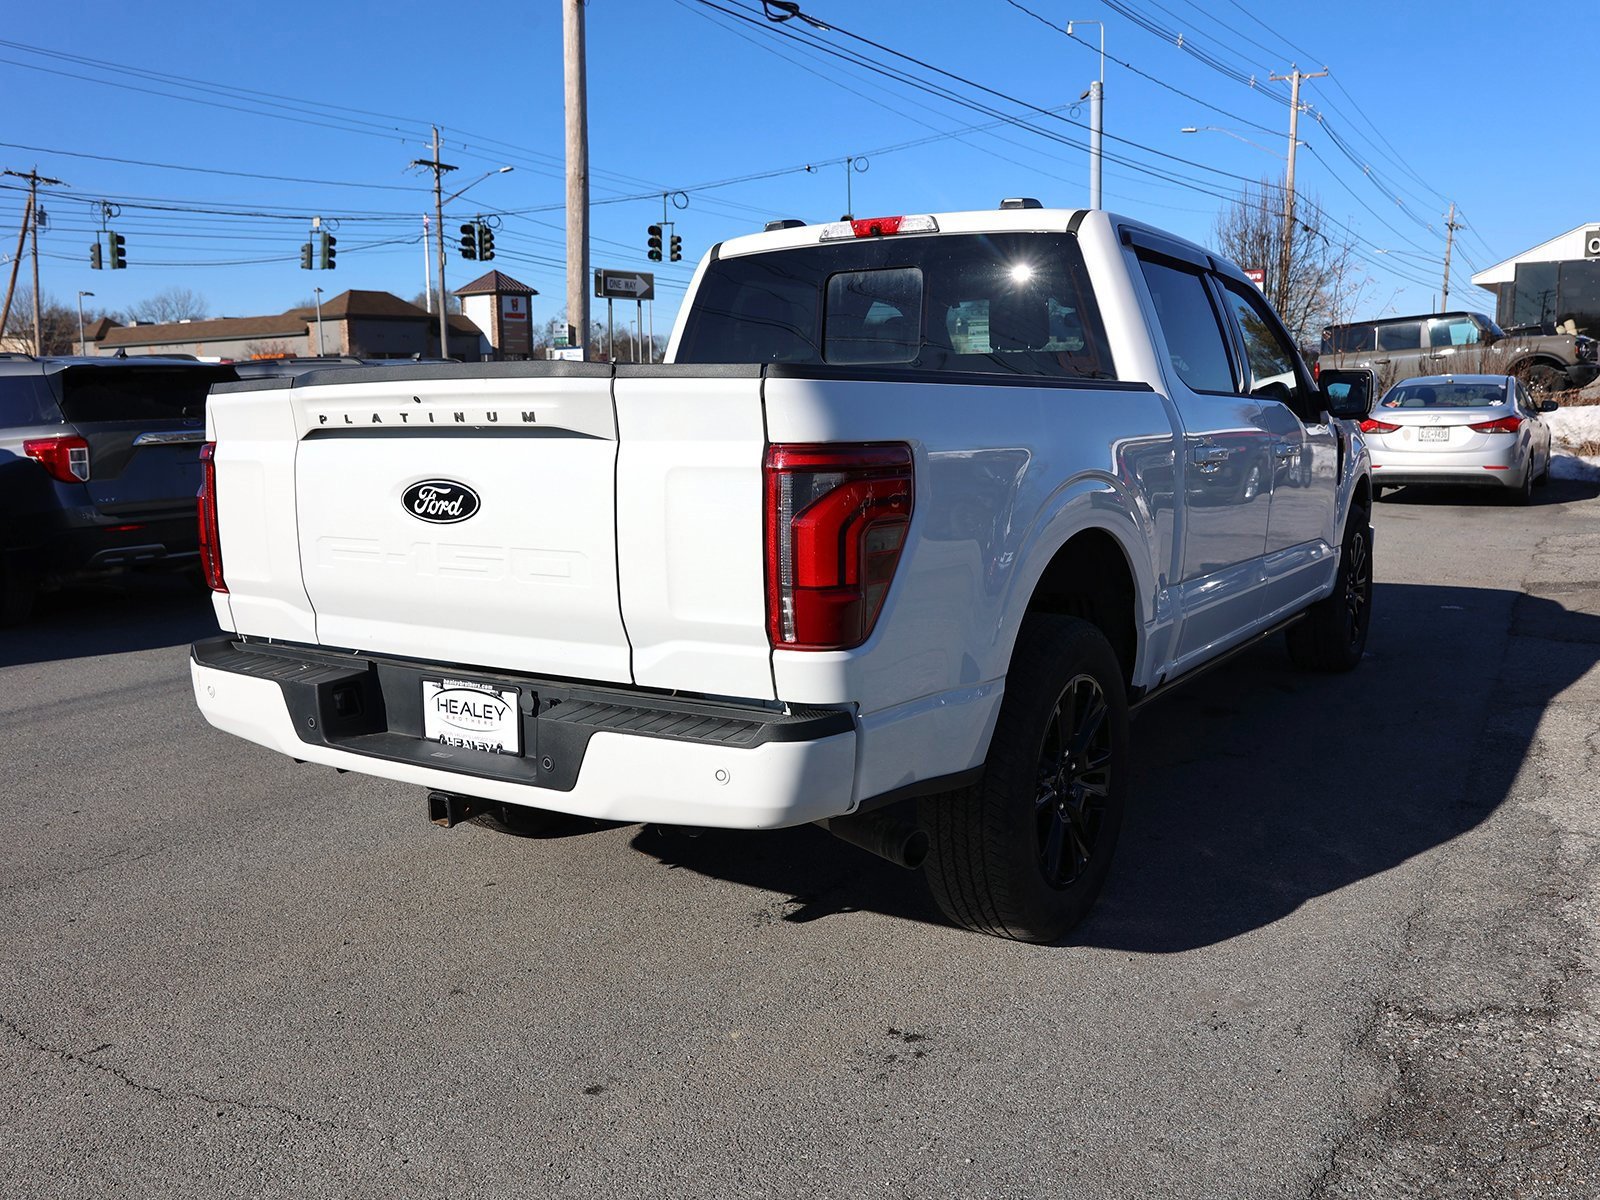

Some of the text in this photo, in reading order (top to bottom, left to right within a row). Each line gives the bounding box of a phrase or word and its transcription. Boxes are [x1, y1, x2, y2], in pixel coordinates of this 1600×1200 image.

[609, 279, 637, 290] ONE WAY
[318, 411, 536, 425] PLATINUM
[414, 485, 464, 517] Ford
[443, 679, 493, 690] healeybrothers.com
[437, 697, 506, 721] HEALEY
[446, 714, 494, 727] BROTHERS
[446, 737, 494, 753] HEALEY
